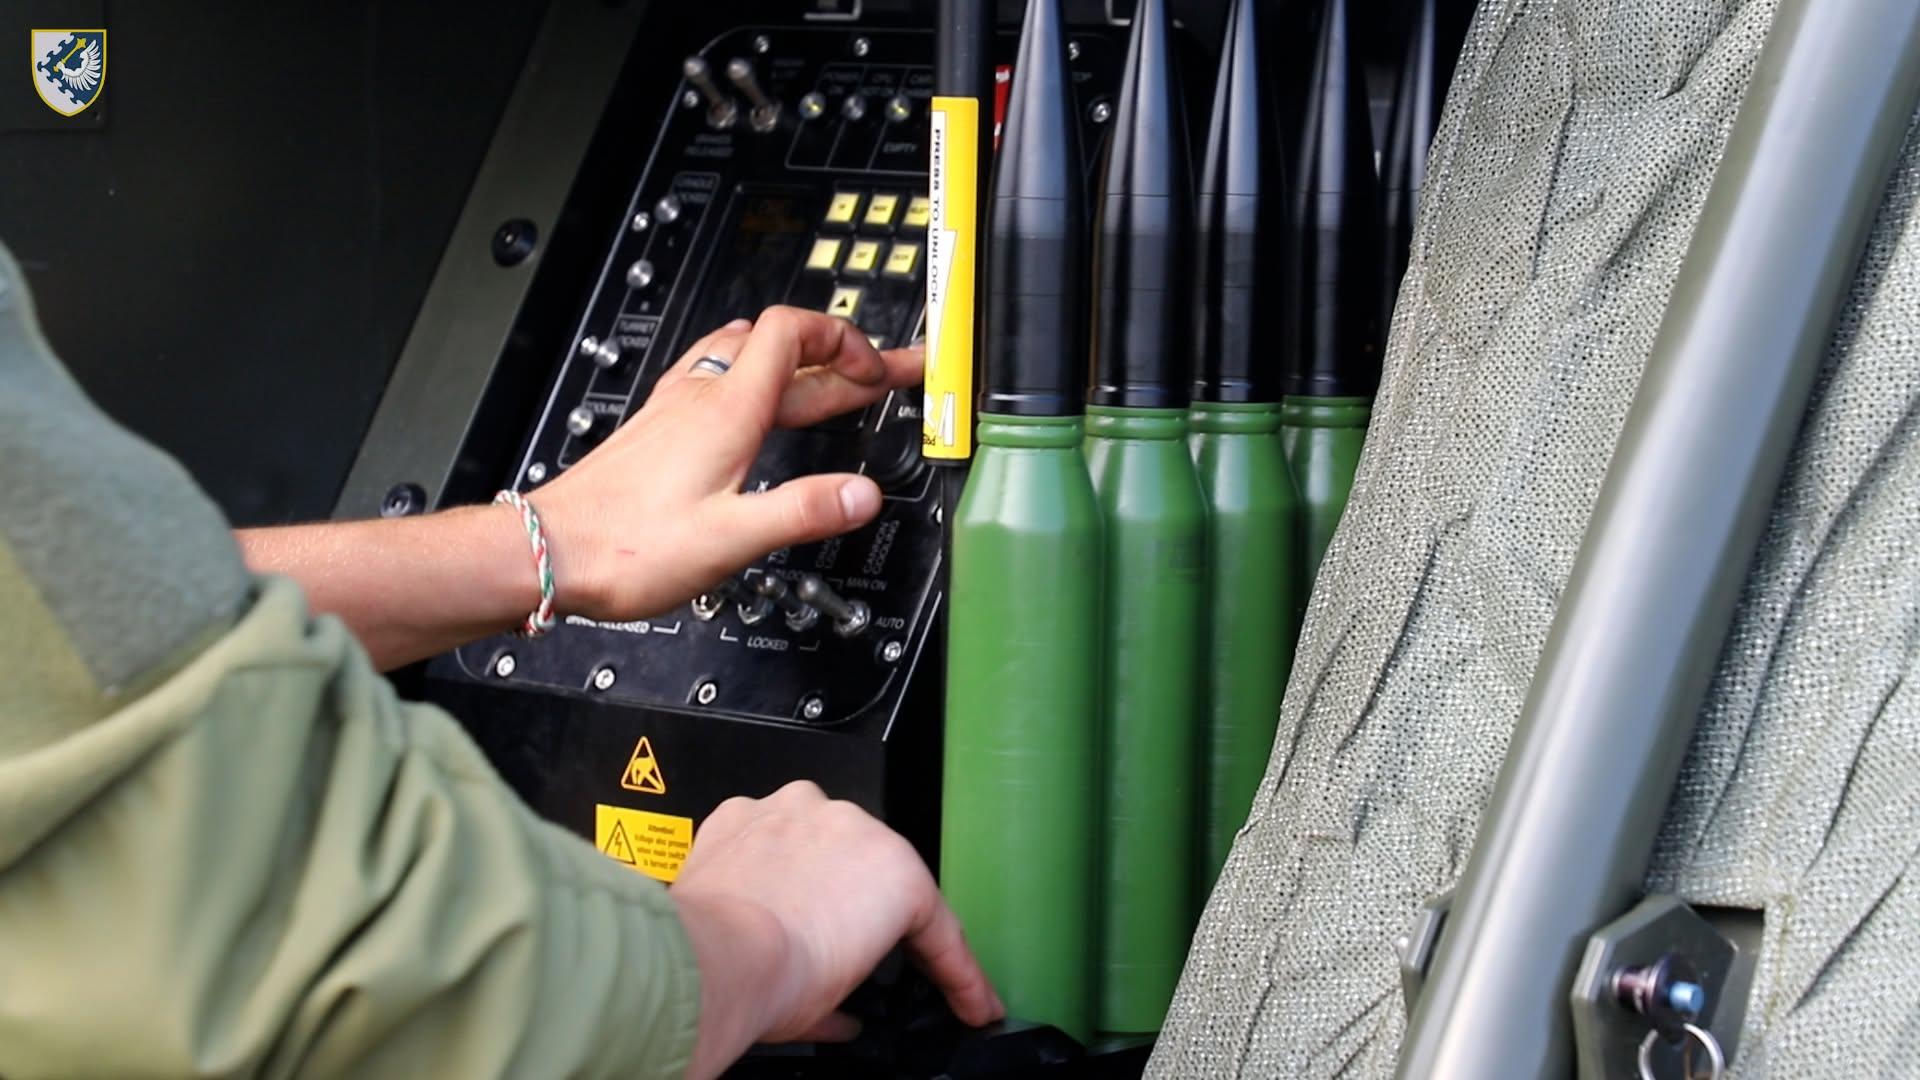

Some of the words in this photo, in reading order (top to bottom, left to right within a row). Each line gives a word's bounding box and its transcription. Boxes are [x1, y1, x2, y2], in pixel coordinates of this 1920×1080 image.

[933, 128, 941, 191] PRESS
[932, 198, 940, 223] TO
[931, 227, 939, 304] UNLOCK
[876, 617, 904, 629] AUTO
[747, 637, 789, 650] LOCKED
